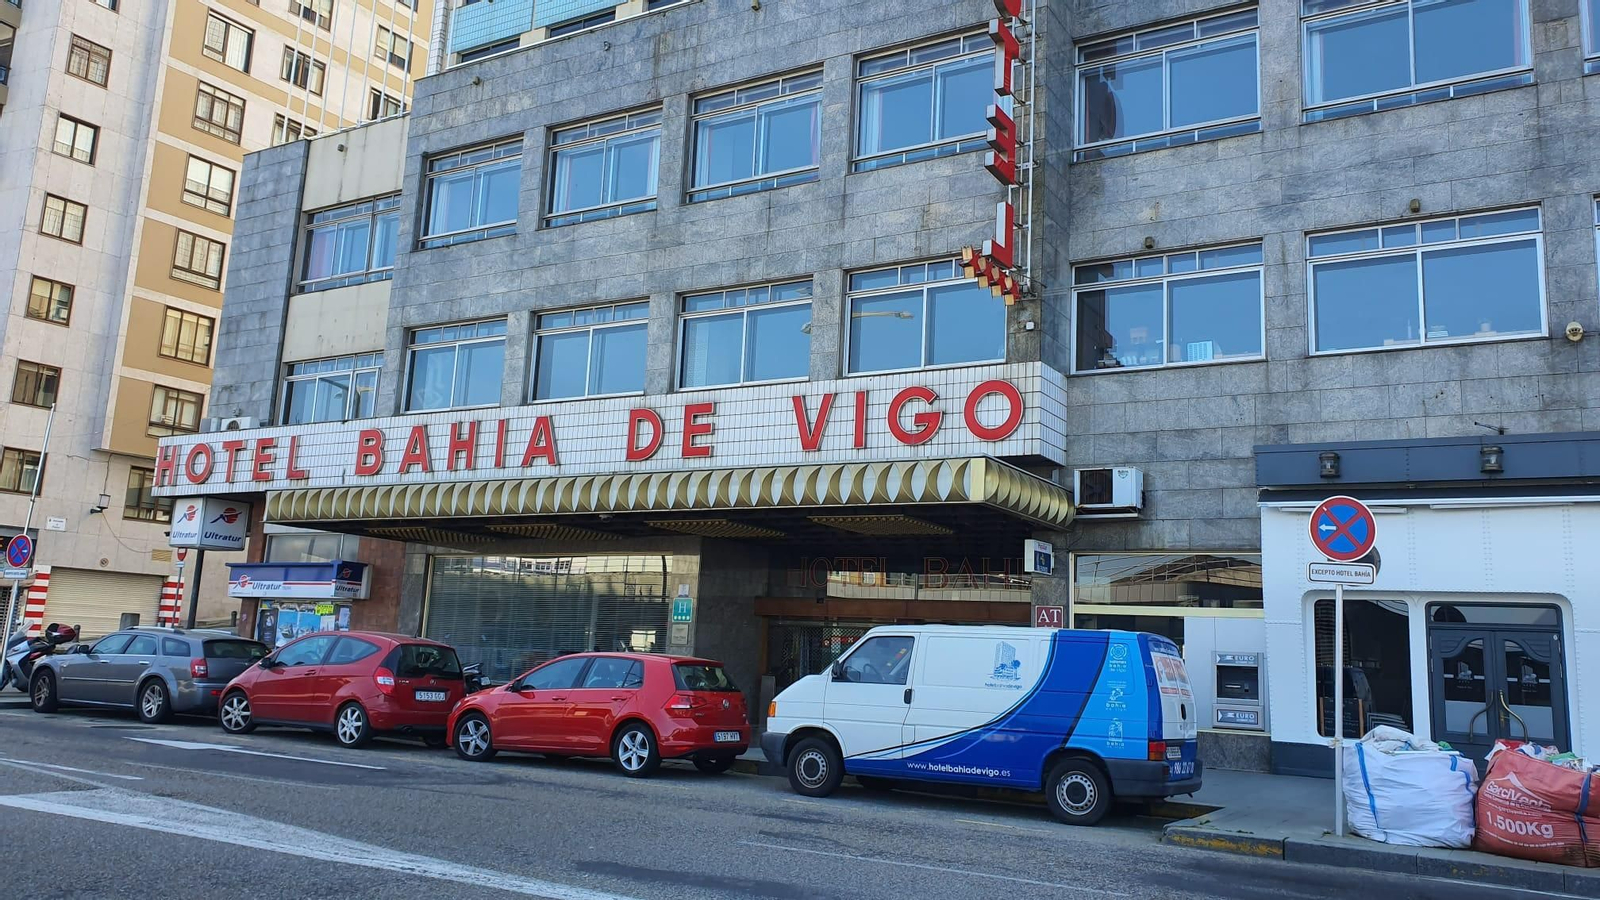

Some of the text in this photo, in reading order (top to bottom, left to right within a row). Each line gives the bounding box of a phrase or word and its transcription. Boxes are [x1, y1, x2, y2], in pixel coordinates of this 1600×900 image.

[155, 379, 1025, 487] HOTEL BAHIA DE VIGO
[172, 531, 198, 539] Ultratur
[204, 531, 242, 542] Ultratur
[1311, 568, 1371, 578] EXCEPTO HOTEL BAHÍA
[252, 582, 281, 591] Ultratur
[335, 584, 360, 593] Ultratur
[678, 602, 687, 613] H
[1037, 609, 1061, 623] AT
[906, 762, 1011, 777] www.hotelbahiadevigo.es
[1486, 811, 1554, 839] 1.500Kg
